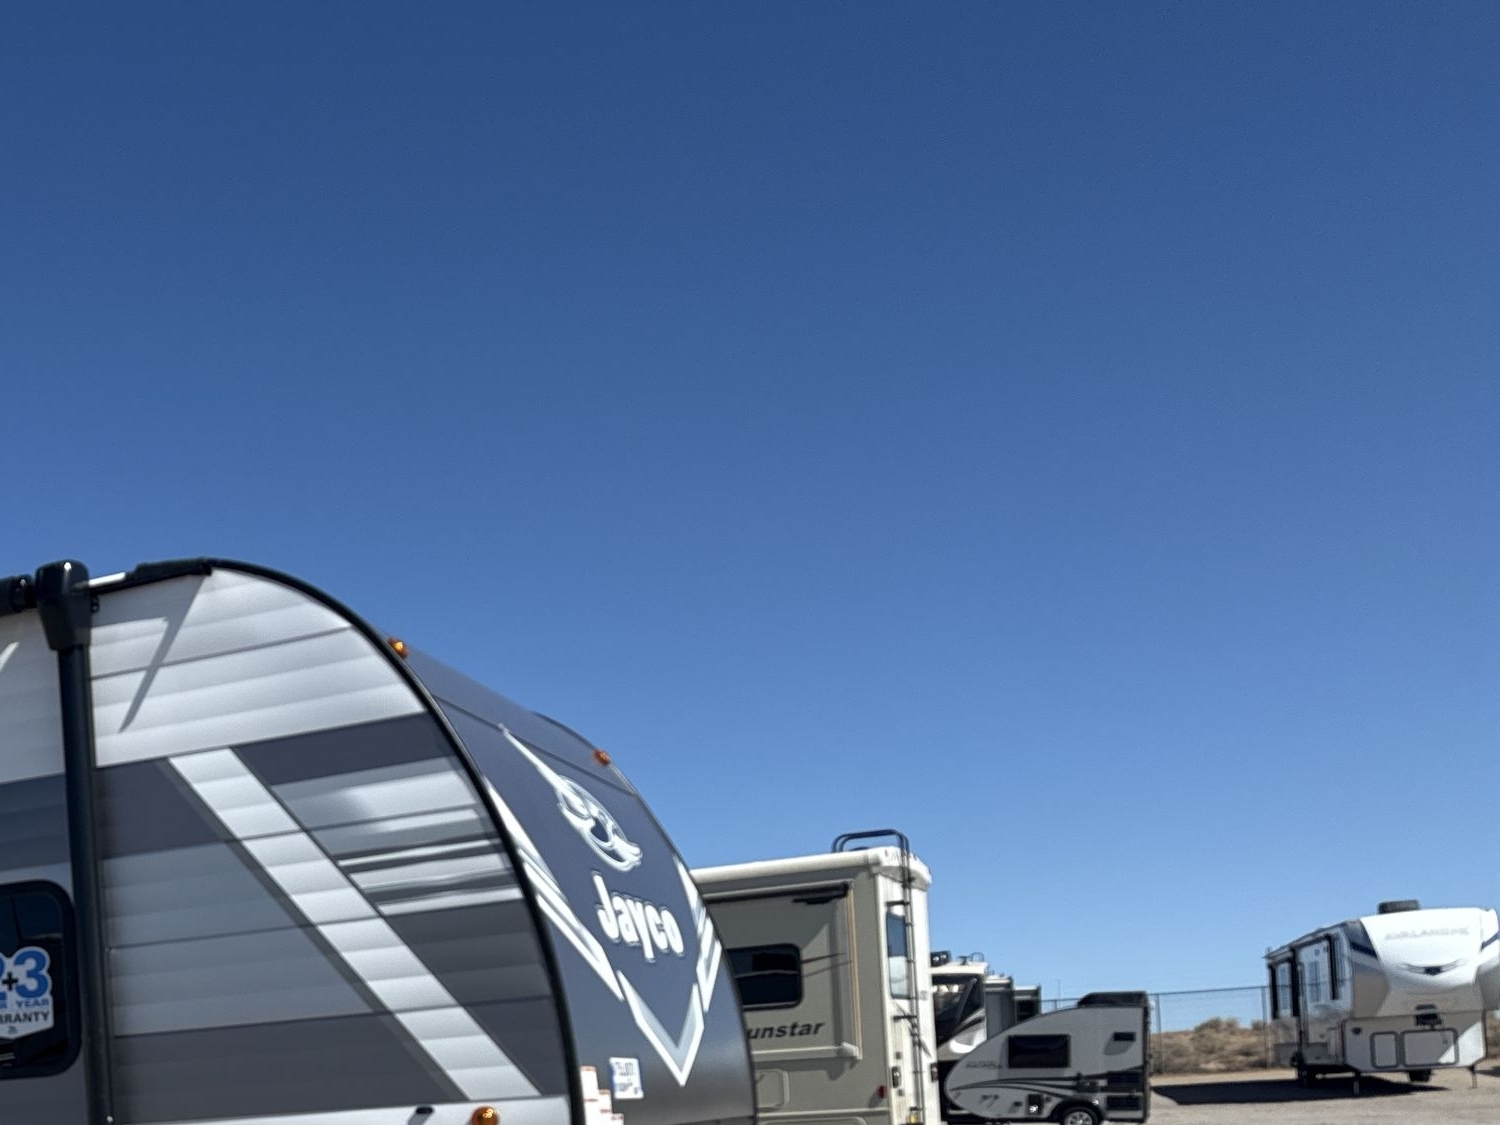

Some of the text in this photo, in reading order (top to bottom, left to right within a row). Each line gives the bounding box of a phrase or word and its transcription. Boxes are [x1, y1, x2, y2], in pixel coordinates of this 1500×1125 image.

[591, 870, 685, 963] Jayco
[15, 998, 49, 1008] YEAR
[746, 1022, 826, 1040] unstar
